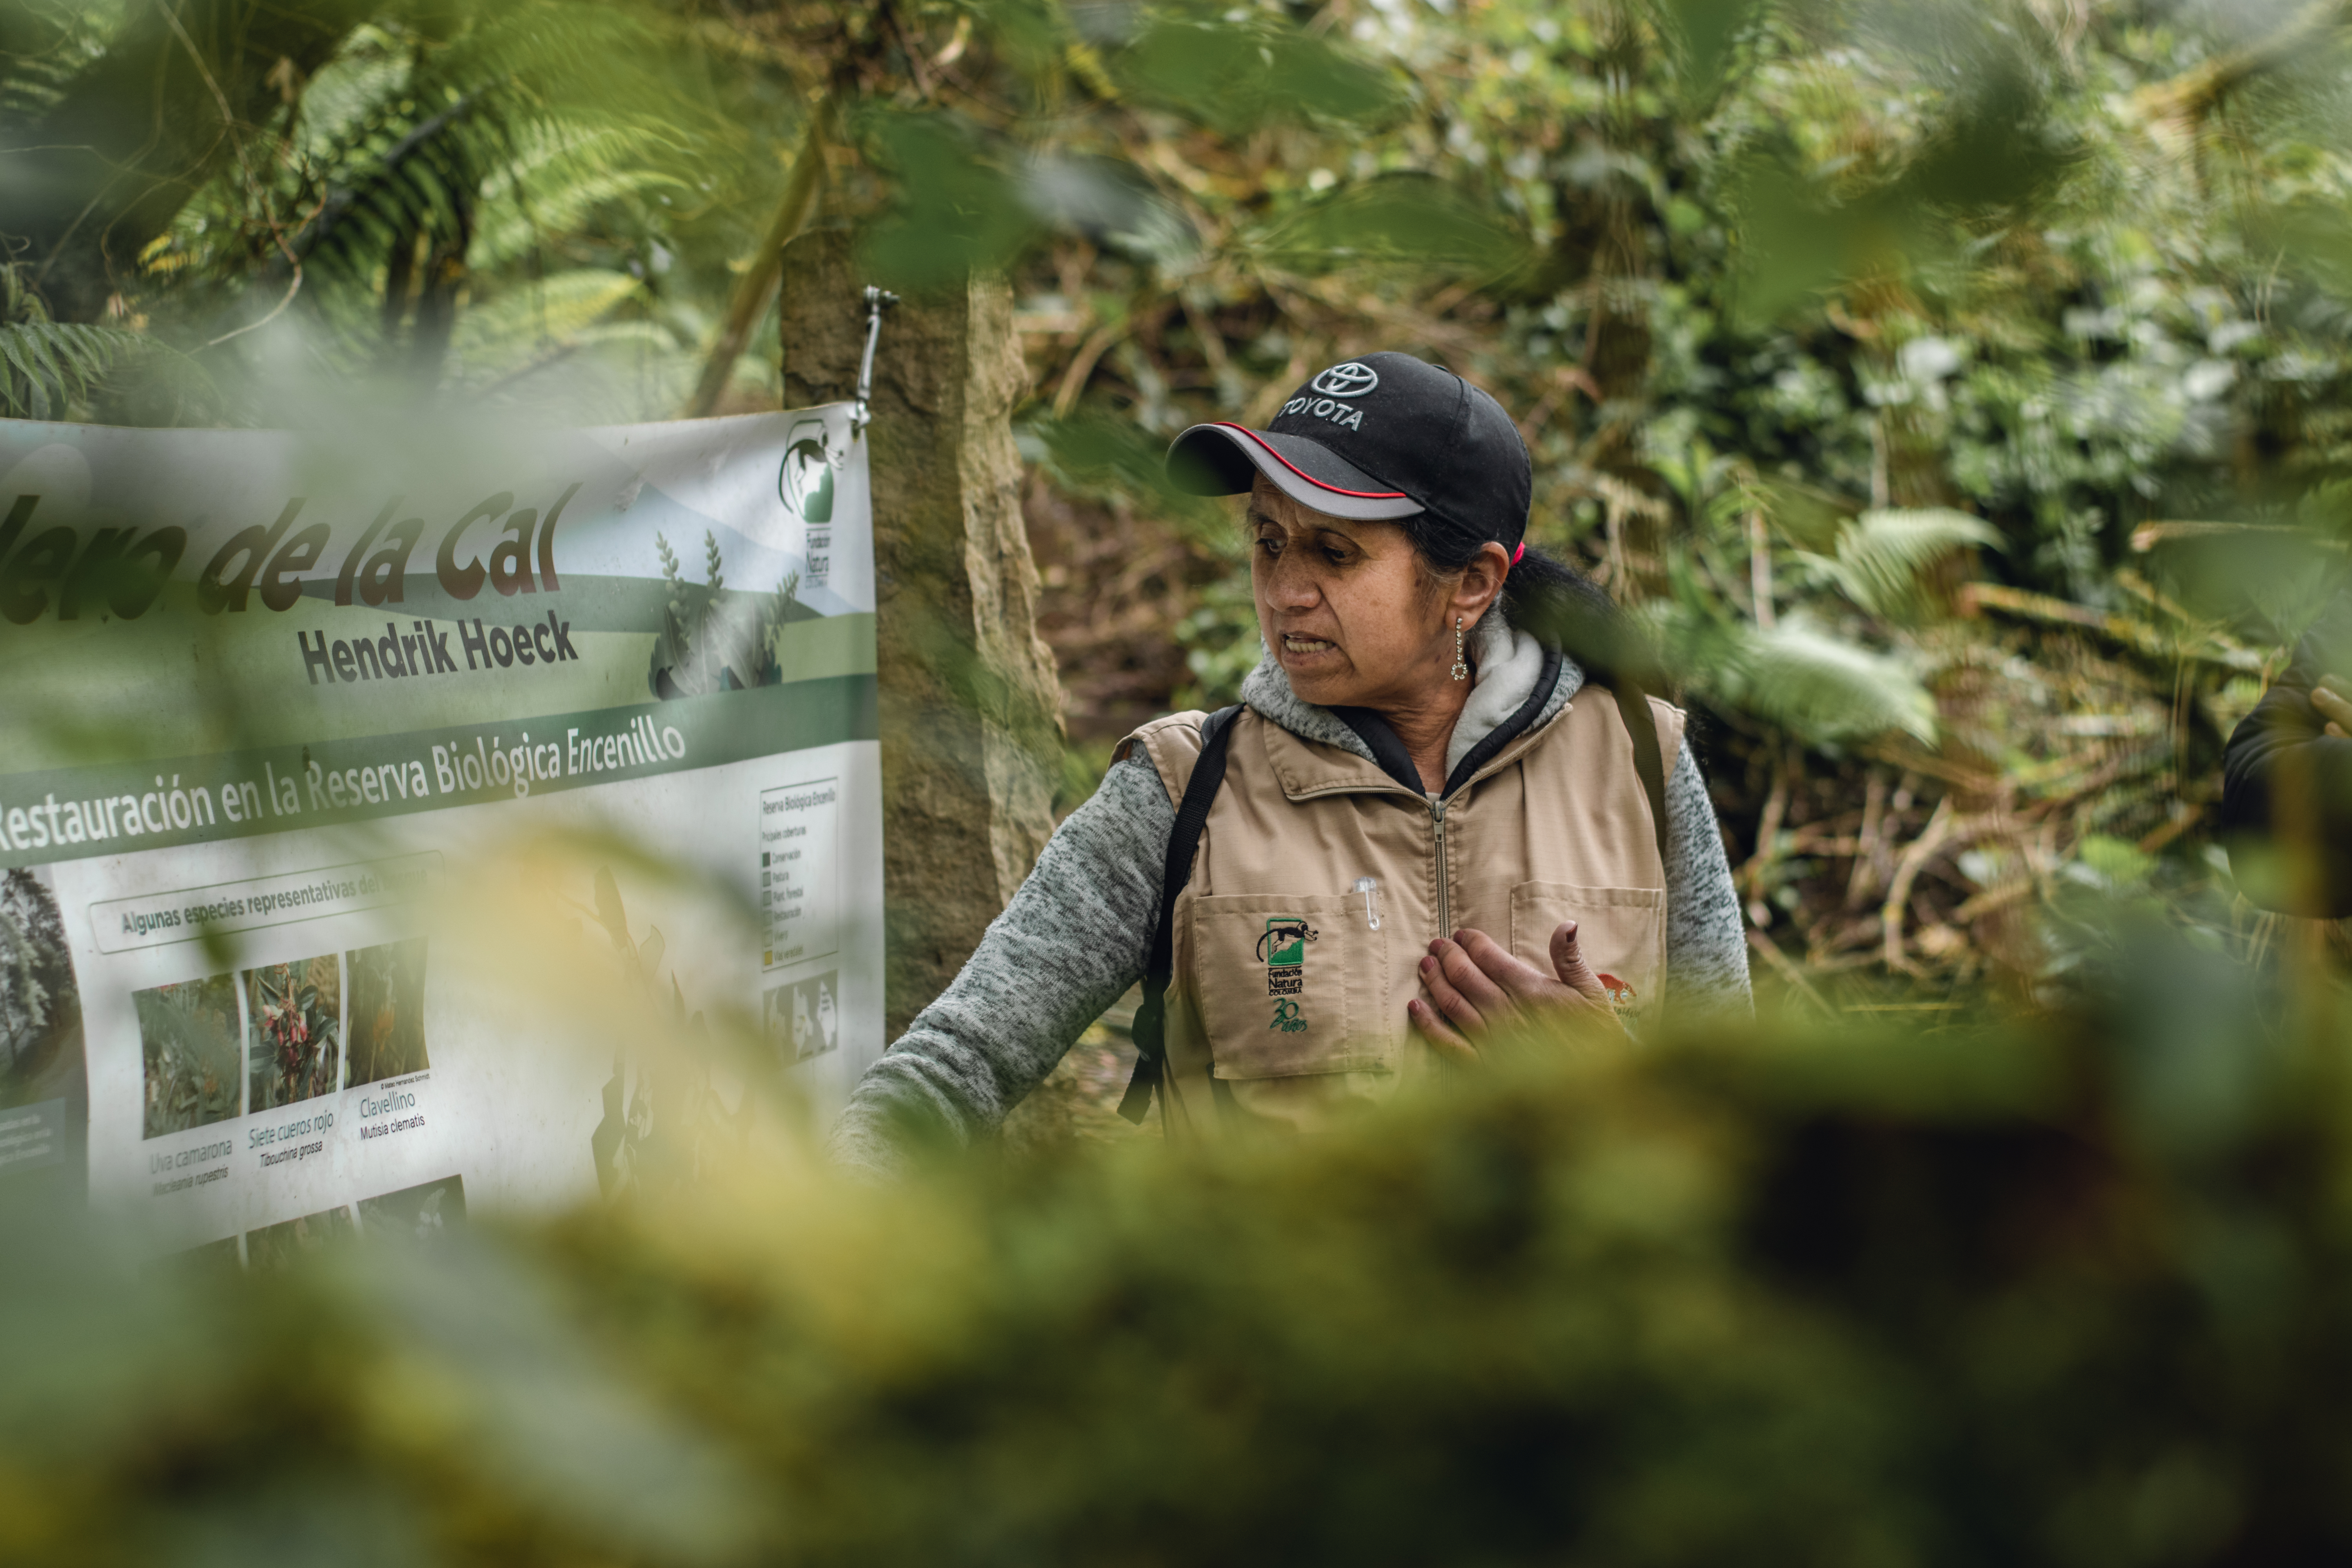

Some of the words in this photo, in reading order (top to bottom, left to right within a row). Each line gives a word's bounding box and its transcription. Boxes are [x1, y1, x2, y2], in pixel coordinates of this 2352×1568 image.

[1278, 397, 1363, 431] TOYOTA
[198, 497, 330, 616] de
[335, 495, 425, 606] la
[436, 482, 583, 601] Cal
[806, 551, 829, 573] Natura
[298, 619, 458, 685] Hendrik
[457, 610, 578, 671] Hoeck
[221, 781, 263, 822] en
[265, 762, 301, 816] la
[305, 760, 430, 811] Reserva
[432, 732, 560, 799] Biológica
[567, 715, 685, 775] Encenillo
[122, 908, 181, 935] Algunas
[184, 897, 245, 926] especies
[247, 880, 356, 915] representativas
[358, 873, 380, 895] del
[1268, 968, 1302, 978] Fundación
[1269, 978, 1303, 989] Natura
[1269, 988, 1302, 996] COLOMBIA
[1281, 1017, 1307, 1032] años
[415, 1073, 430, 1082] Schmidt
[361, 1091, 415, 1118] Clavellino
[249, 1127, 275, 1149] Siete
[278, 1118, 311, 1141] cueros
[314, 1110, 334, 1134] rojo
[361, 1122, 388, 1140] Mutisia
[390, 1113, 425, 1132] clematis
[176, 1140, 232, 1167] camarona
[260, 1147, 297, 1168] Tibouchina
[299, 1141, 323, 1160] grossa
[195, 1163, 229, 1187] rupestris
